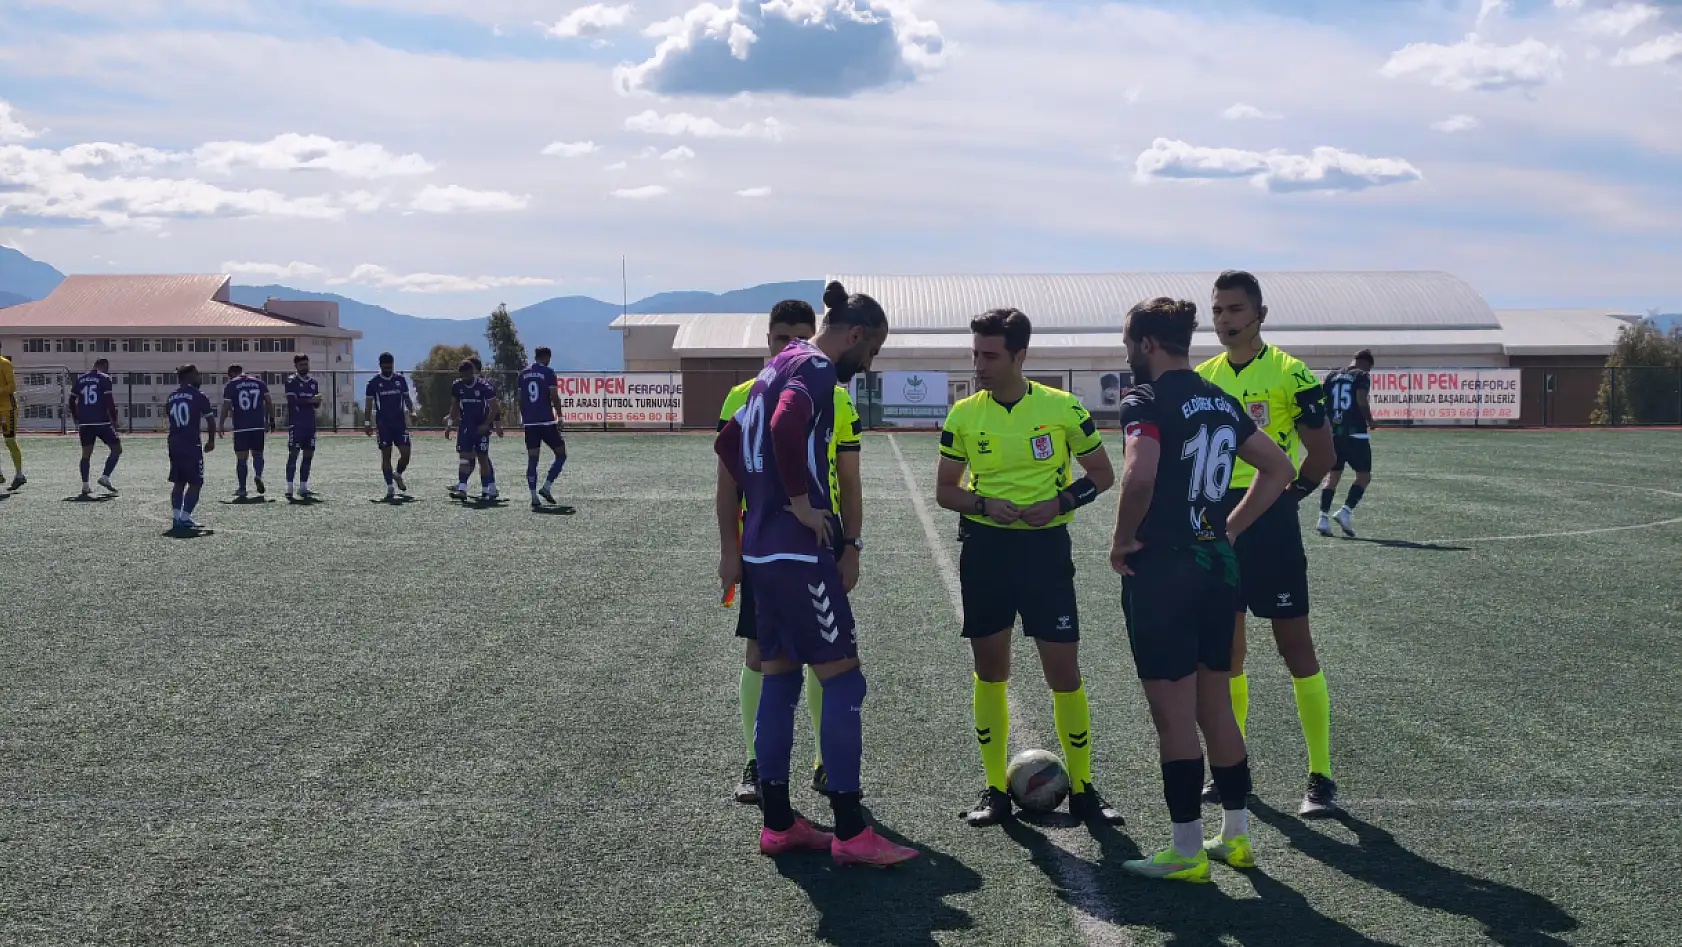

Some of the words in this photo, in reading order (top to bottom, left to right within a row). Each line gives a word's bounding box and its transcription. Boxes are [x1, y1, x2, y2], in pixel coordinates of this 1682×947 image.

[528, 381, 539, 402] 9
[556, 377, 591, 396] RÇIN
[594, 377, 625, 394] PEN
[628, 384, 682, 394] FERFORJE
[1371, 373, 1423, 392] HIRÇIN
[1427, 373, 1458, 390] PEN
[1461, 380, 1516, 390] FERFORJE
[81, 385, 97, 405] 15
[239, 389, 260, 410] 67
[576, 398, 600, 408] ARASI
[603, 398, 633, 408] FUTBOL
[636, 398, 681, 408] TURNUVASI
[1332, 383, 1352, 410] 15
[170, 402, 189, 428] 10
[605, 412, 623, 421] 533
[626, 412, 645, 421] 669
[1181, 423, 1237, 502] 16
